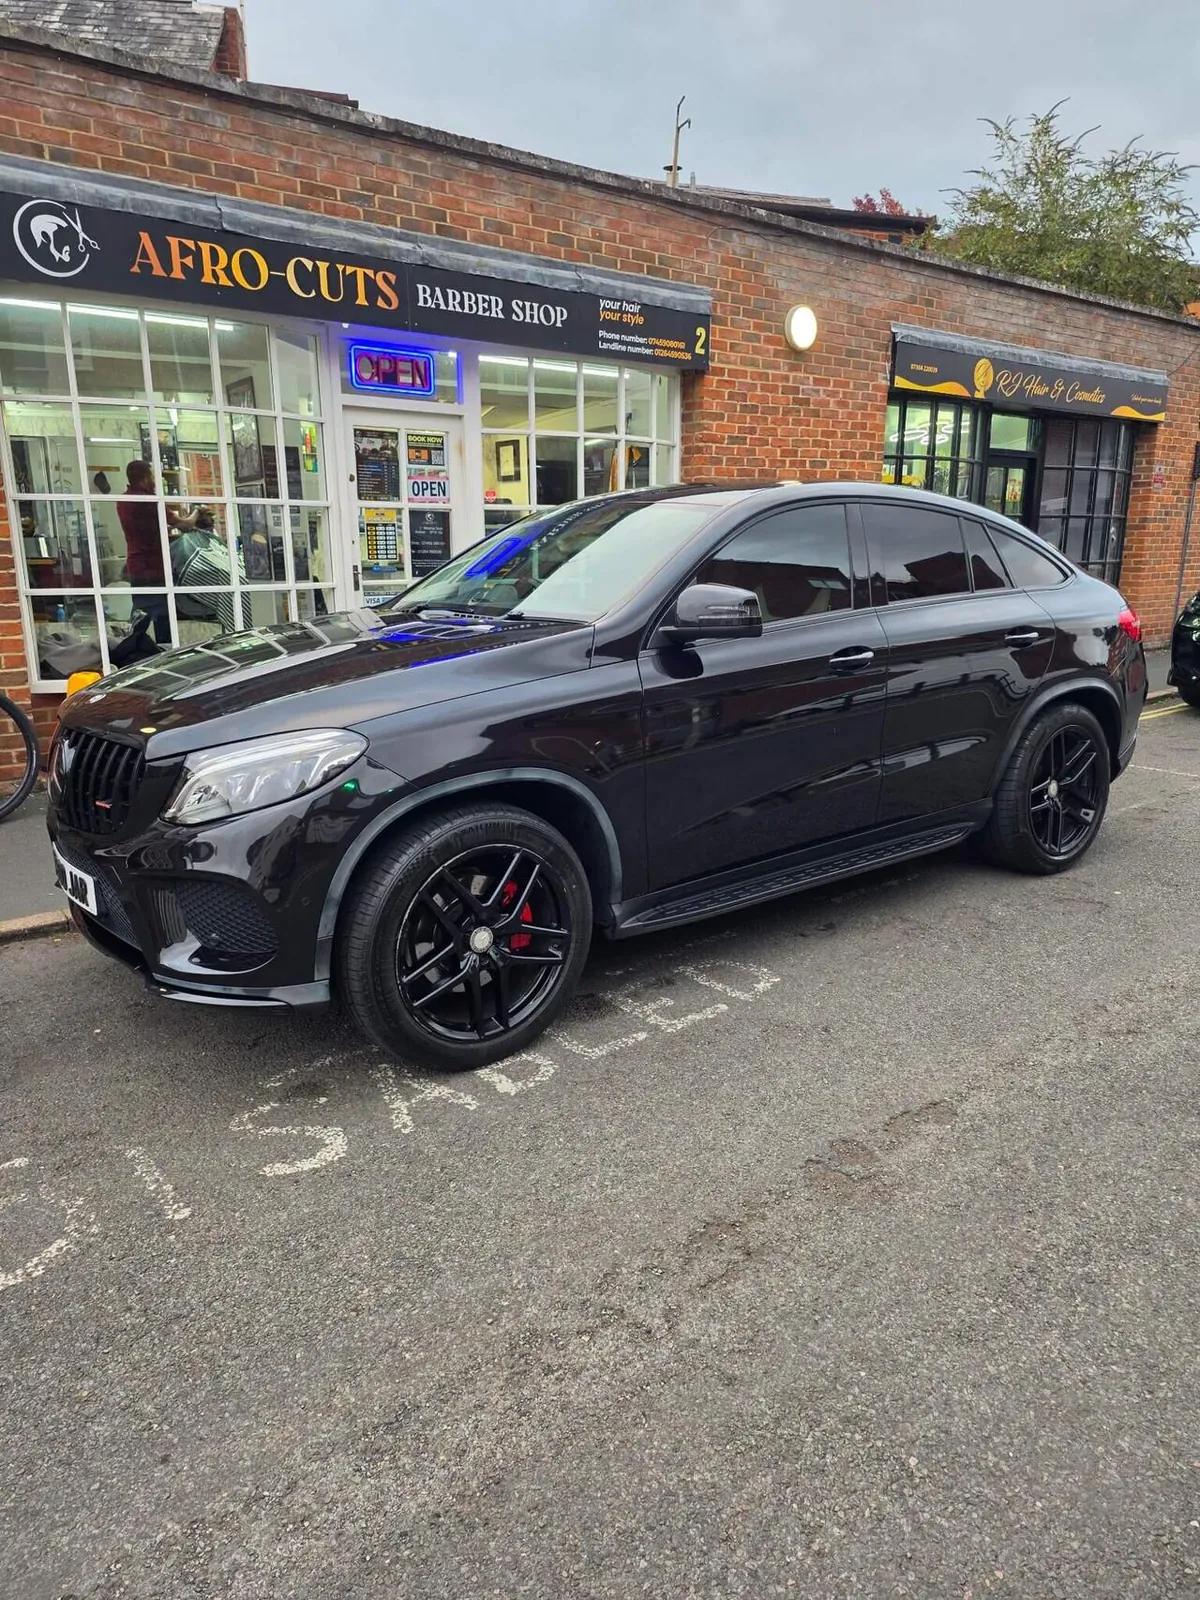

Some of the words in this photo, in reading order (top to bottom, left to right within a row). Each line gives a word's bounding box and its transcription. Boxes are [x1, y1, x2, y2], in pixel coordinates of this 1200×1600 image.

[130, 231, 399, 310] AFRO-CUTS
[416, 284, 505, 319] BARBER
[511, 299, 568, 327] SHOP
[600, 299, 620, 311] your
[622, 301, 641, 313] hair
[600, 310, 620, 322] your
[623, 313, 644, 326] style
[599, 330, 620, 340] Phone
[621, 335, 647, 345] number:
[695, 327, 706, 355] 2
[599, 341, 626, 351] Landline
[627, 346, 653, 356] number:
[355, 352, 431, 391] OPEN
[996, 370, 1023, 397] RJ
[1023, 375, 1049, 398] Hair
[1050, 379, 1065, 403] &
[1066, 381, 1106, 404] Cosmetics
[407, 435, 426, 443] BOOK
[412, 481, 446, 497] OPEN
